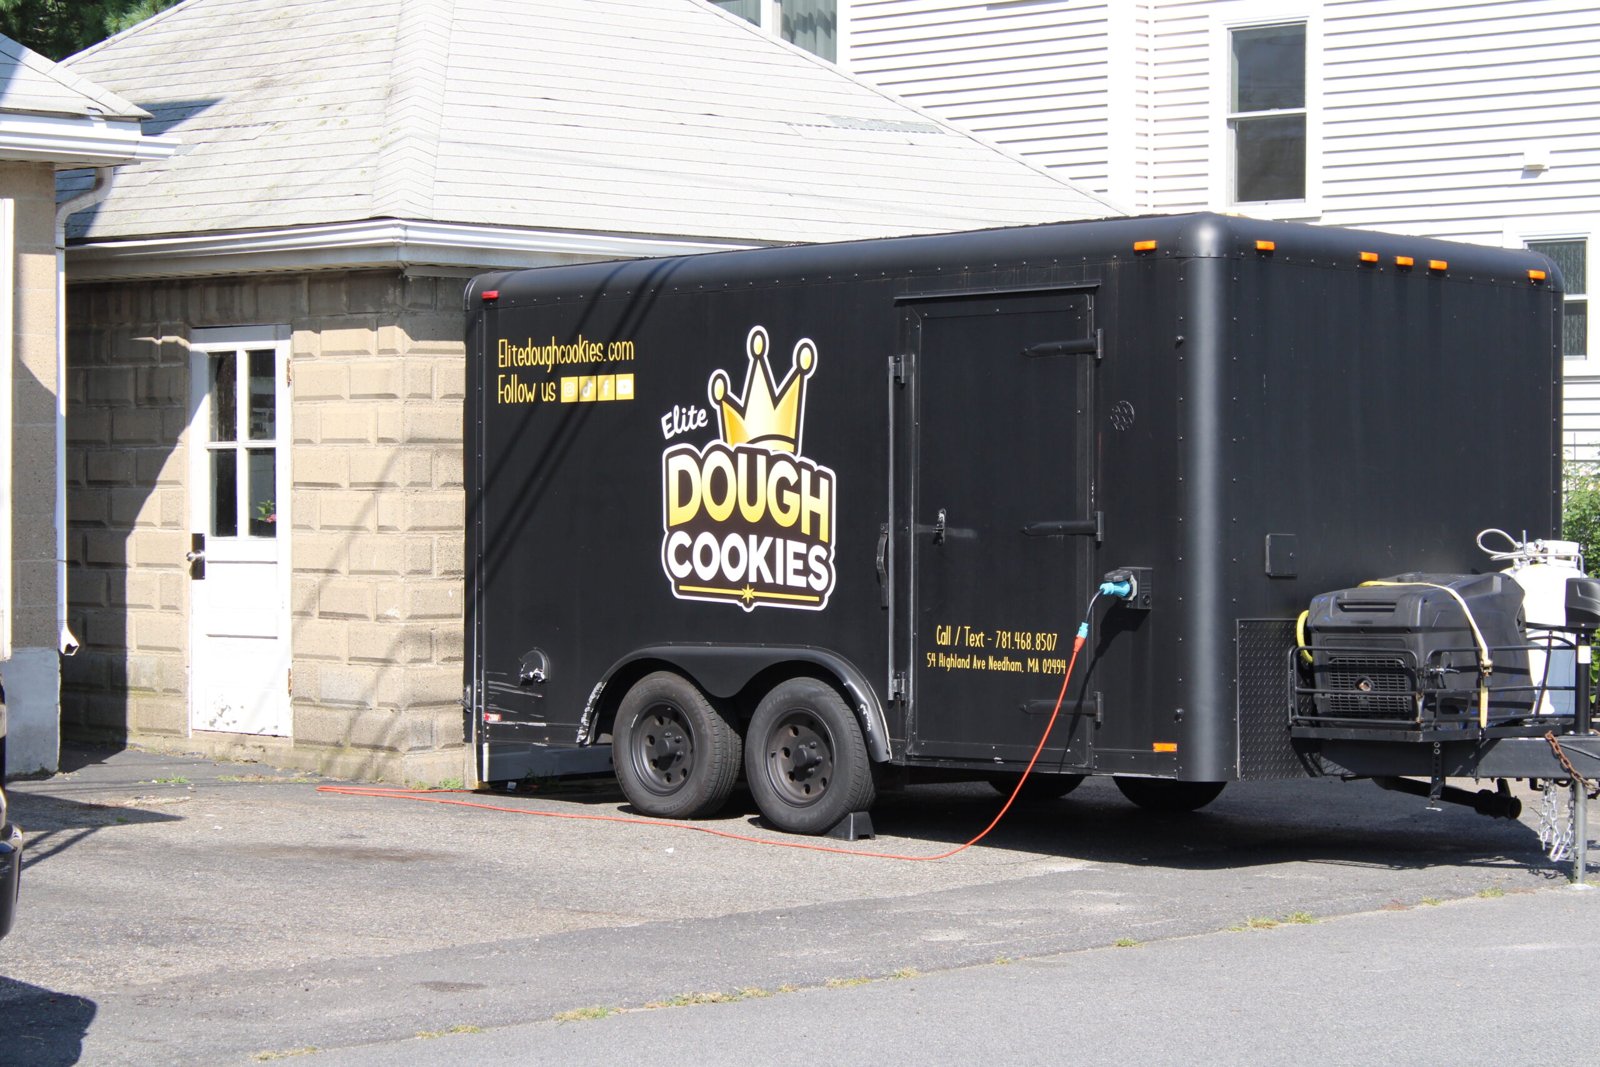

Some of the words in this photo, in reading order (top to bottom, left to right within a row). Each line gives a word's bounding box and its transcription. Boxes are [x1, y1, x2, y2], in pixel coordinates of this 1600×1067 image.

[498, 334, 635, 373] Elitedoughcookies.com
[498, 374, 537, 404] Follow
[541, 381, 556, 402] us
[660, 404, 709, 440] Elite
[668, 450, 829, 543] DOUGH
[667, 530, 829, 592] COOKIES
[936, 625, 952, 646] Call
[954, 625, 961, 646] /
[964, 626, 985, 648] Text
[995, 630, 1058, 651] 781.468.8507
[926, 652, 937, 668] 54
[938, 653, 971, 672] Highland
[972, 654, 986, 670] Ave
[1027, 658, 1040, 673] MA
[1042, 658, 1067, 675] 02494
